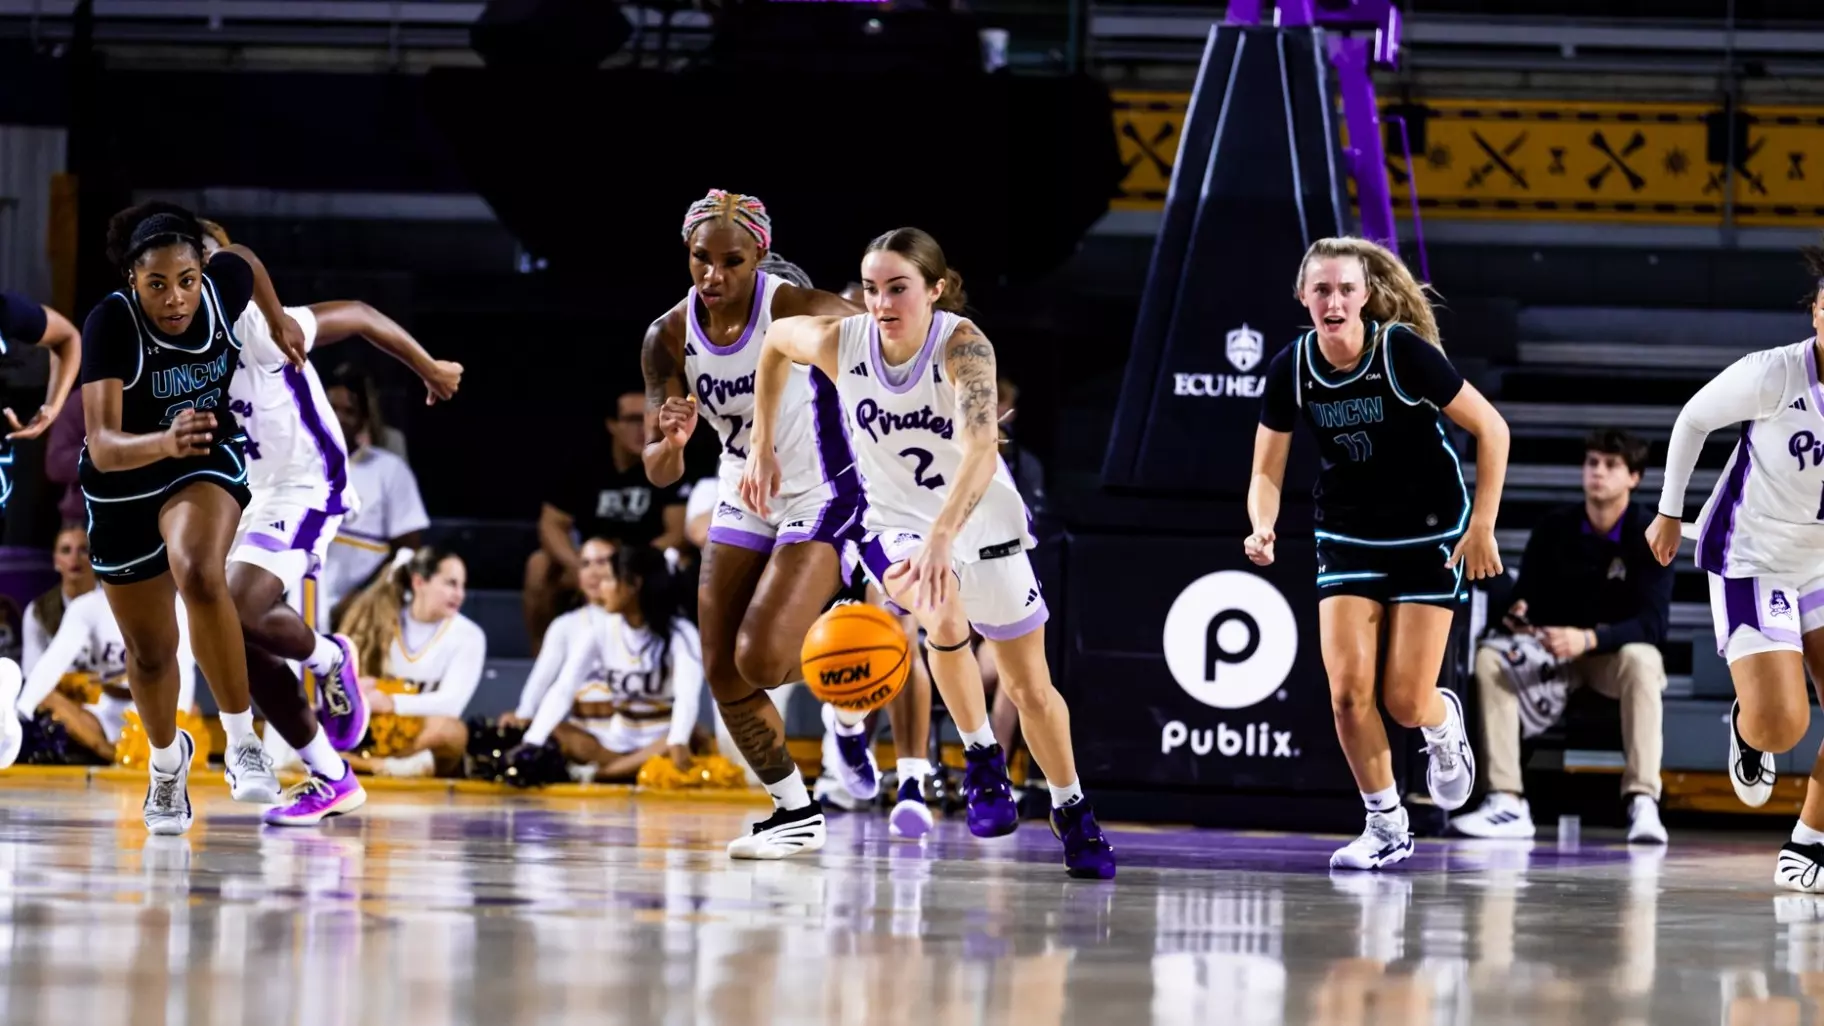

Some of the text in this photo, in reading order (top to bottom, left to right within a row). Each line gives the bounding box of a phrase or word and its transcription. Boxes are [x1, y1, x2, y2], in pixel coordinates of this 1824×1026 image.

[152, 348, 228, 398] UNCW
[1173, 372, 1225, 396] ECU
[856, 398, 954, 444] Pirates
[1308, 396, 1384, 427] UNCW
[898, 447, 946, 490] 2
[819, 661, 871, 687] NCAA
[1161, 719, 1293, 758] Publix
